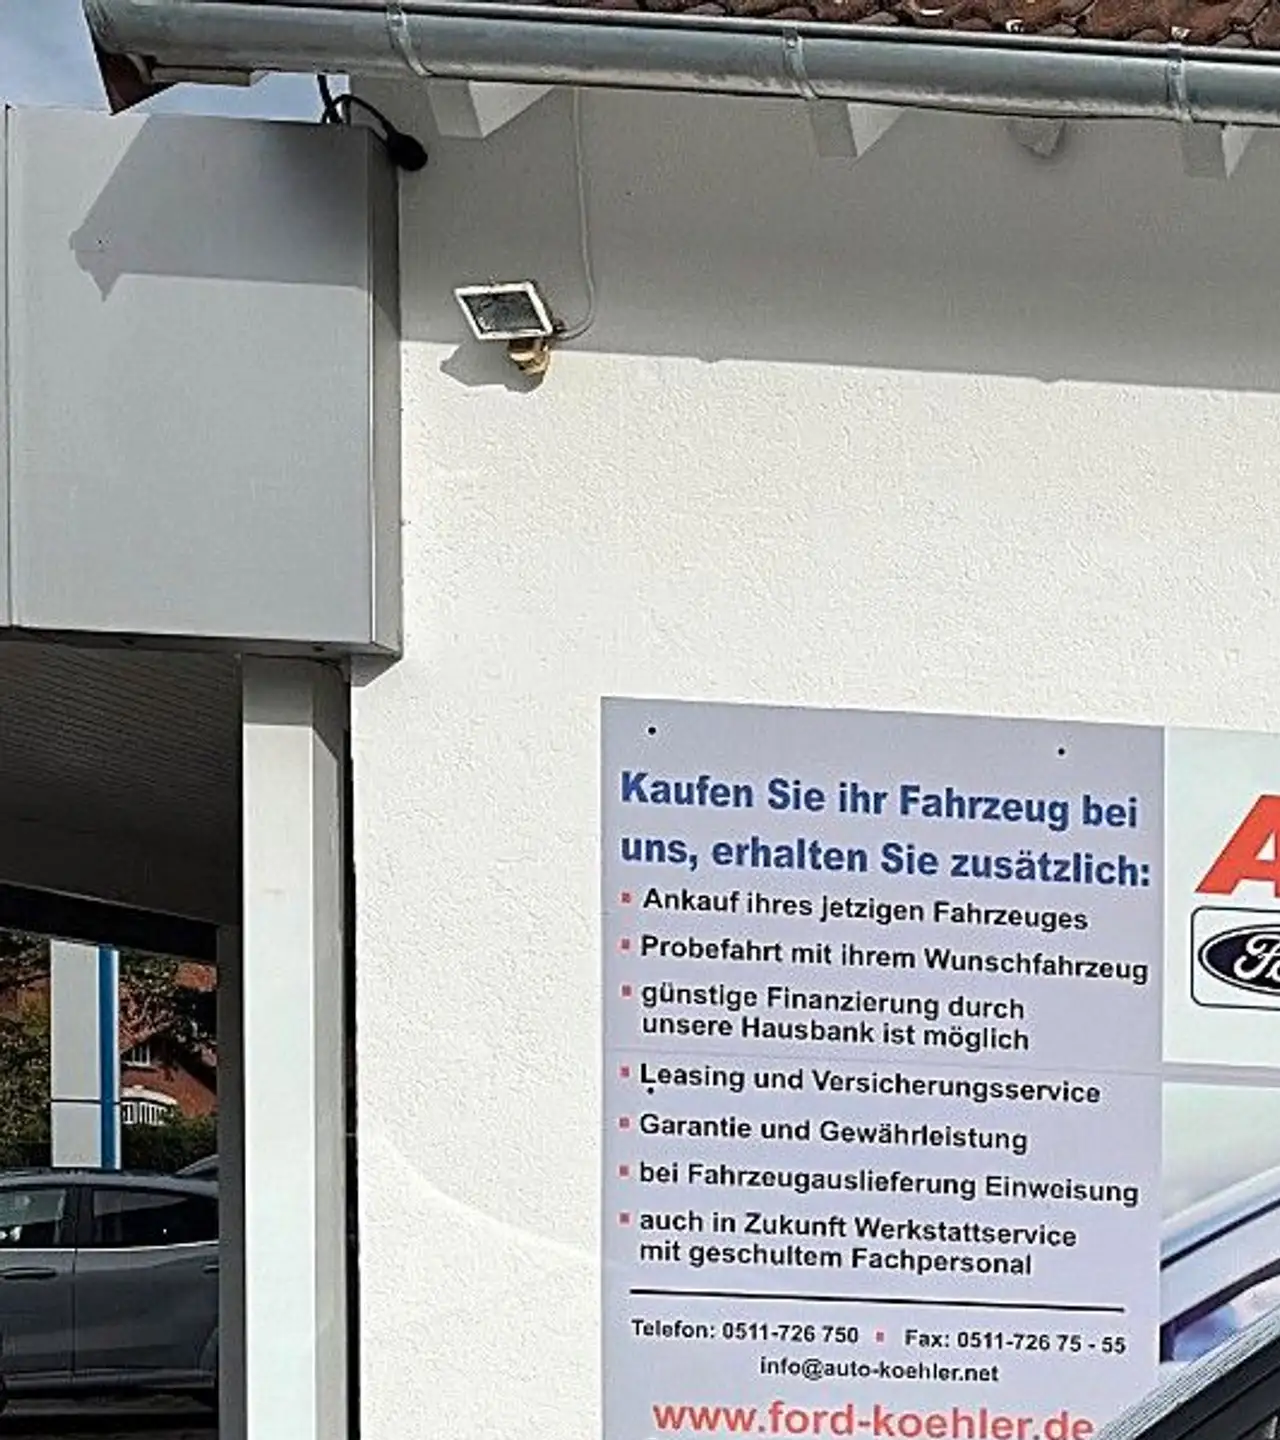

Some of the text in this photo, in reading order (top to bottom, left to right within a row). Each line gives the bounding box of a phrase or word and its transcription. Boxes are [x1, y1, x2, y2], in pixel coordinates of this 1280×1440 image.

[621, 770, 1137, 833] Kaufen Sie ihr Fahrzeug bei
[621, 835, 1150, 887] uns, erhalten Sie zusätzlich:
[642, 887, 1089, 934] Ankauf ihres jetzigen Fahrzeuges
[640, 933, 1149, 986] Probefahrt mit ihrem Wunschfahrzeug
[641, 981, 1024, 1021] günstige Finanzierung durch
[643, 1015, 1029, 1053] unsere Hausbank ist möglich
[640, 1062, 1101, 1104] Leasing und Versicherungsservice
[639, 1113, 1027, 1156] Garantie und Gewährleistung
[640, 1160, 1139, 1208] bei Fahrzeugauslieferung Einweisung
[640, 1209, 1077, 1247] auch in Zukunft Werkstattservice
[640, 1239, 1031, 1276] mit geschultem Fachpersonal
[631, 1318, 859, 1344] Telefon: 0511-726 750
[957, 1331, 1051, 1352] 0511-726
[760, 1355, 999, 1382] info@auto-koehler.net
